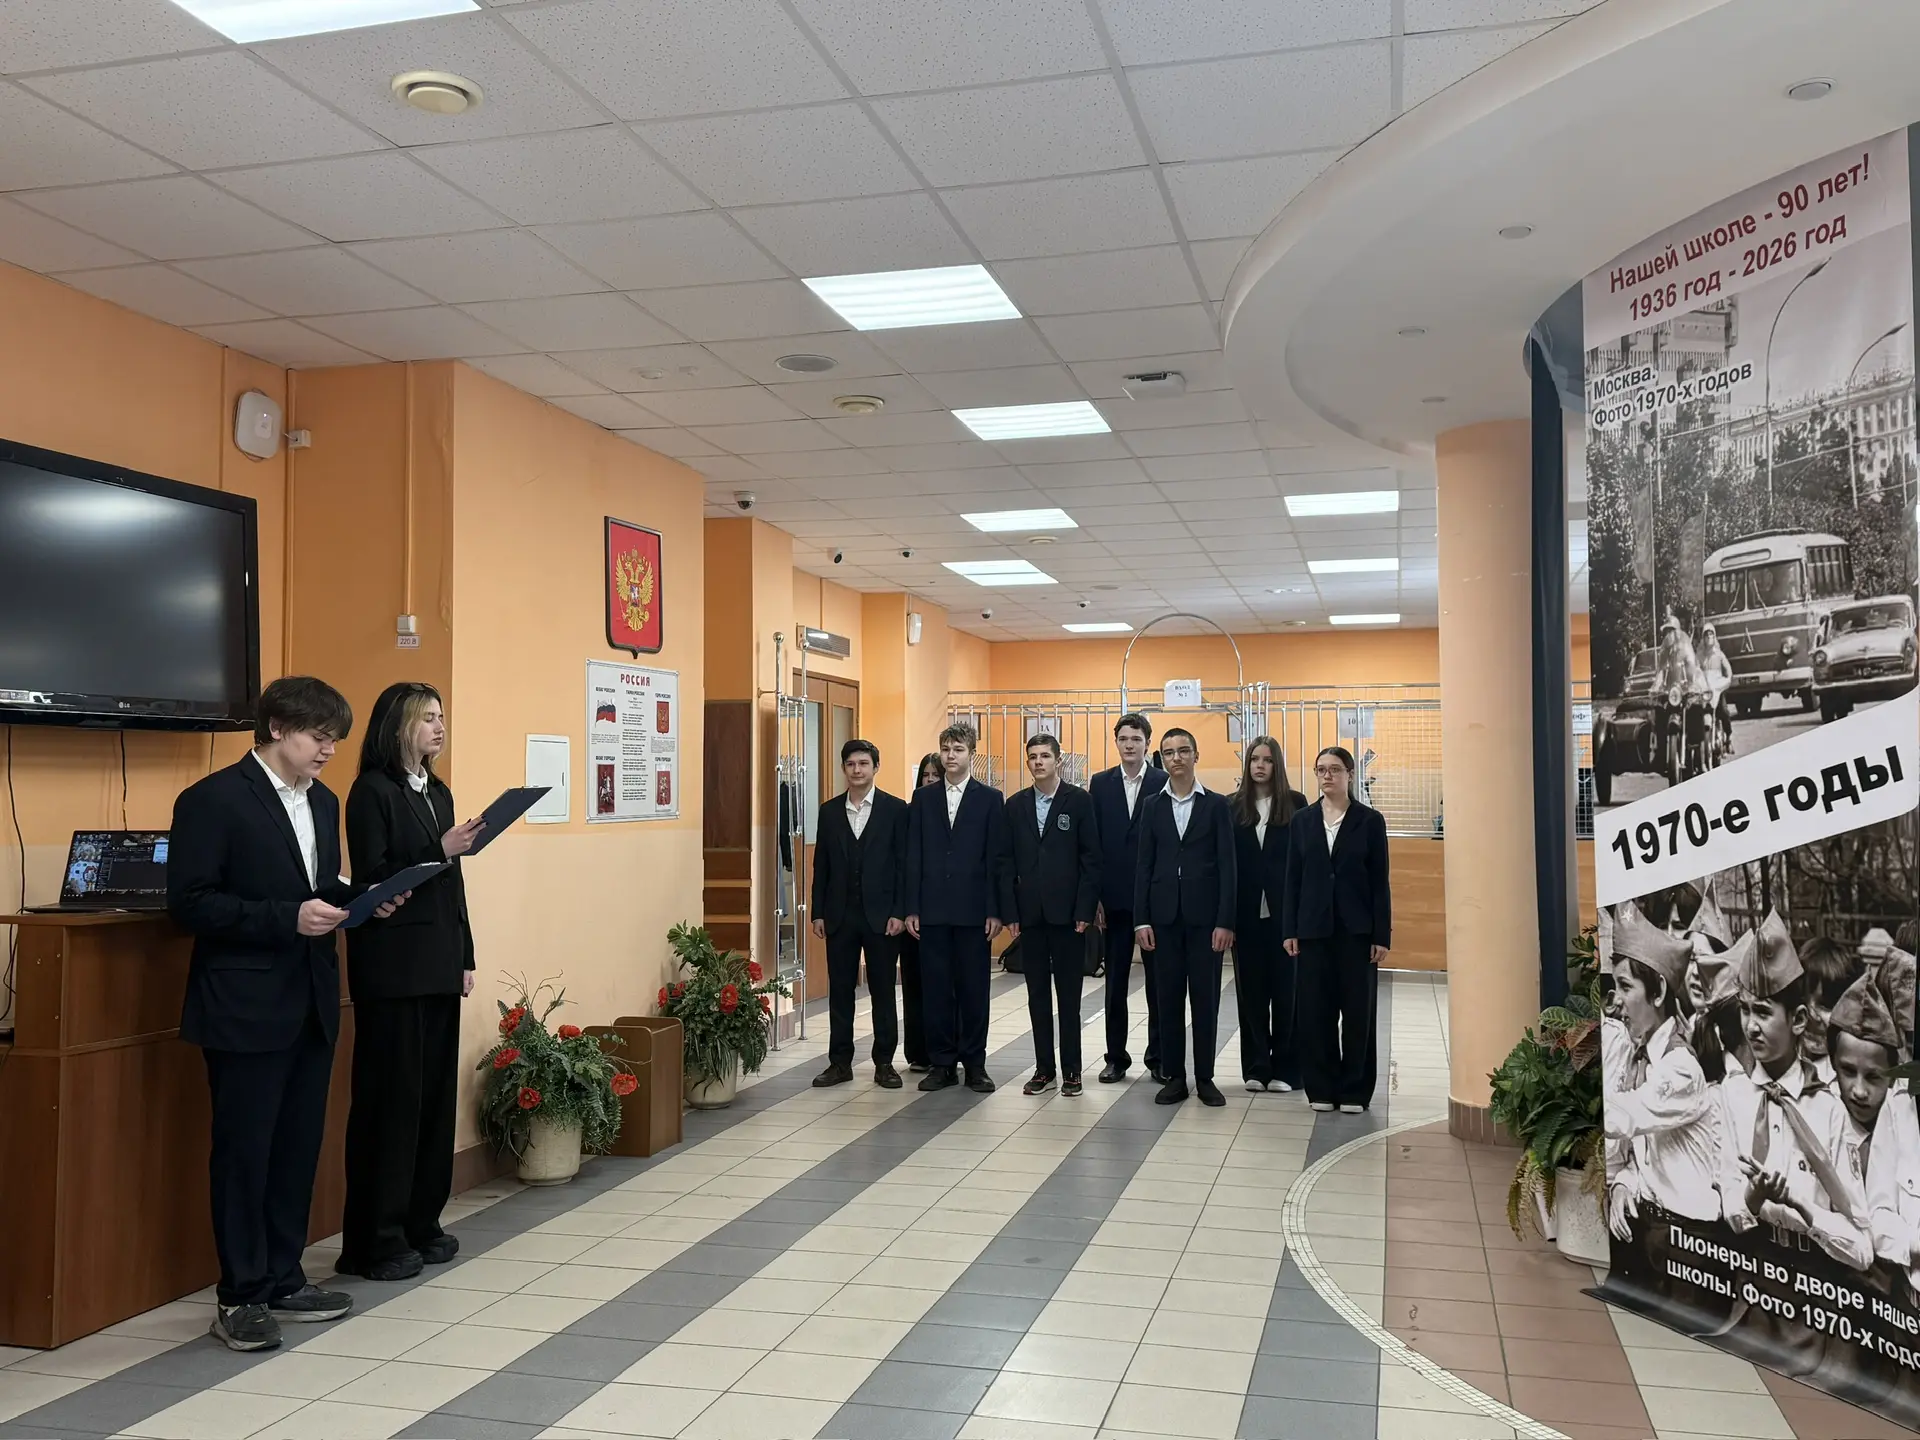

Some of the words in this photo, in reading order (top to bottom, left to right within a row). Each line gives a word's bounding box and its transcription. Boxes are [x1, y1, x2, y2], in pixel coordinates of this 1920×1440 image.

[1610, 245, 1679, 293] Нашей
[1683, 214, 1757, 262] школе
[1764, 212, 1773, 221] -
[1777, 184, 1809, 219] 90
[1817, 153, 1870, 203] лет!
[1629, 283, 1677, 321] 1936
[1684, 269, 1722, 301] год
[1728, 269, 1737, 278] -
[1742, 231, 1797, 278] 2026
[1804, 214, 1847, 249] год
[1593, 365, 1657, 400] Москва.
[1593, 402, 1631, 427] Фото
[1635, 382, 1693, 413] 1970-х
[1697, 363, 1753, 395] годов
[620, 673, 651, 687] РОССИЯ
[1611, 799, 1751, 871] 1970-е
[1763, 745, 1905, 822] годы
[1666, 1259, 1737, 1299] школы.
[1742, 1283, 1796, 1319] Фото
[1802, 1304, 1874, 1349] 1970-х
[1669, 1224, 1758, 1274] Пионеры
[1763, 1261, 1789, 1284] во
[1794, 1272, 1865, 1310] дворе
[1872, 1297, 1920, 1335] наше
